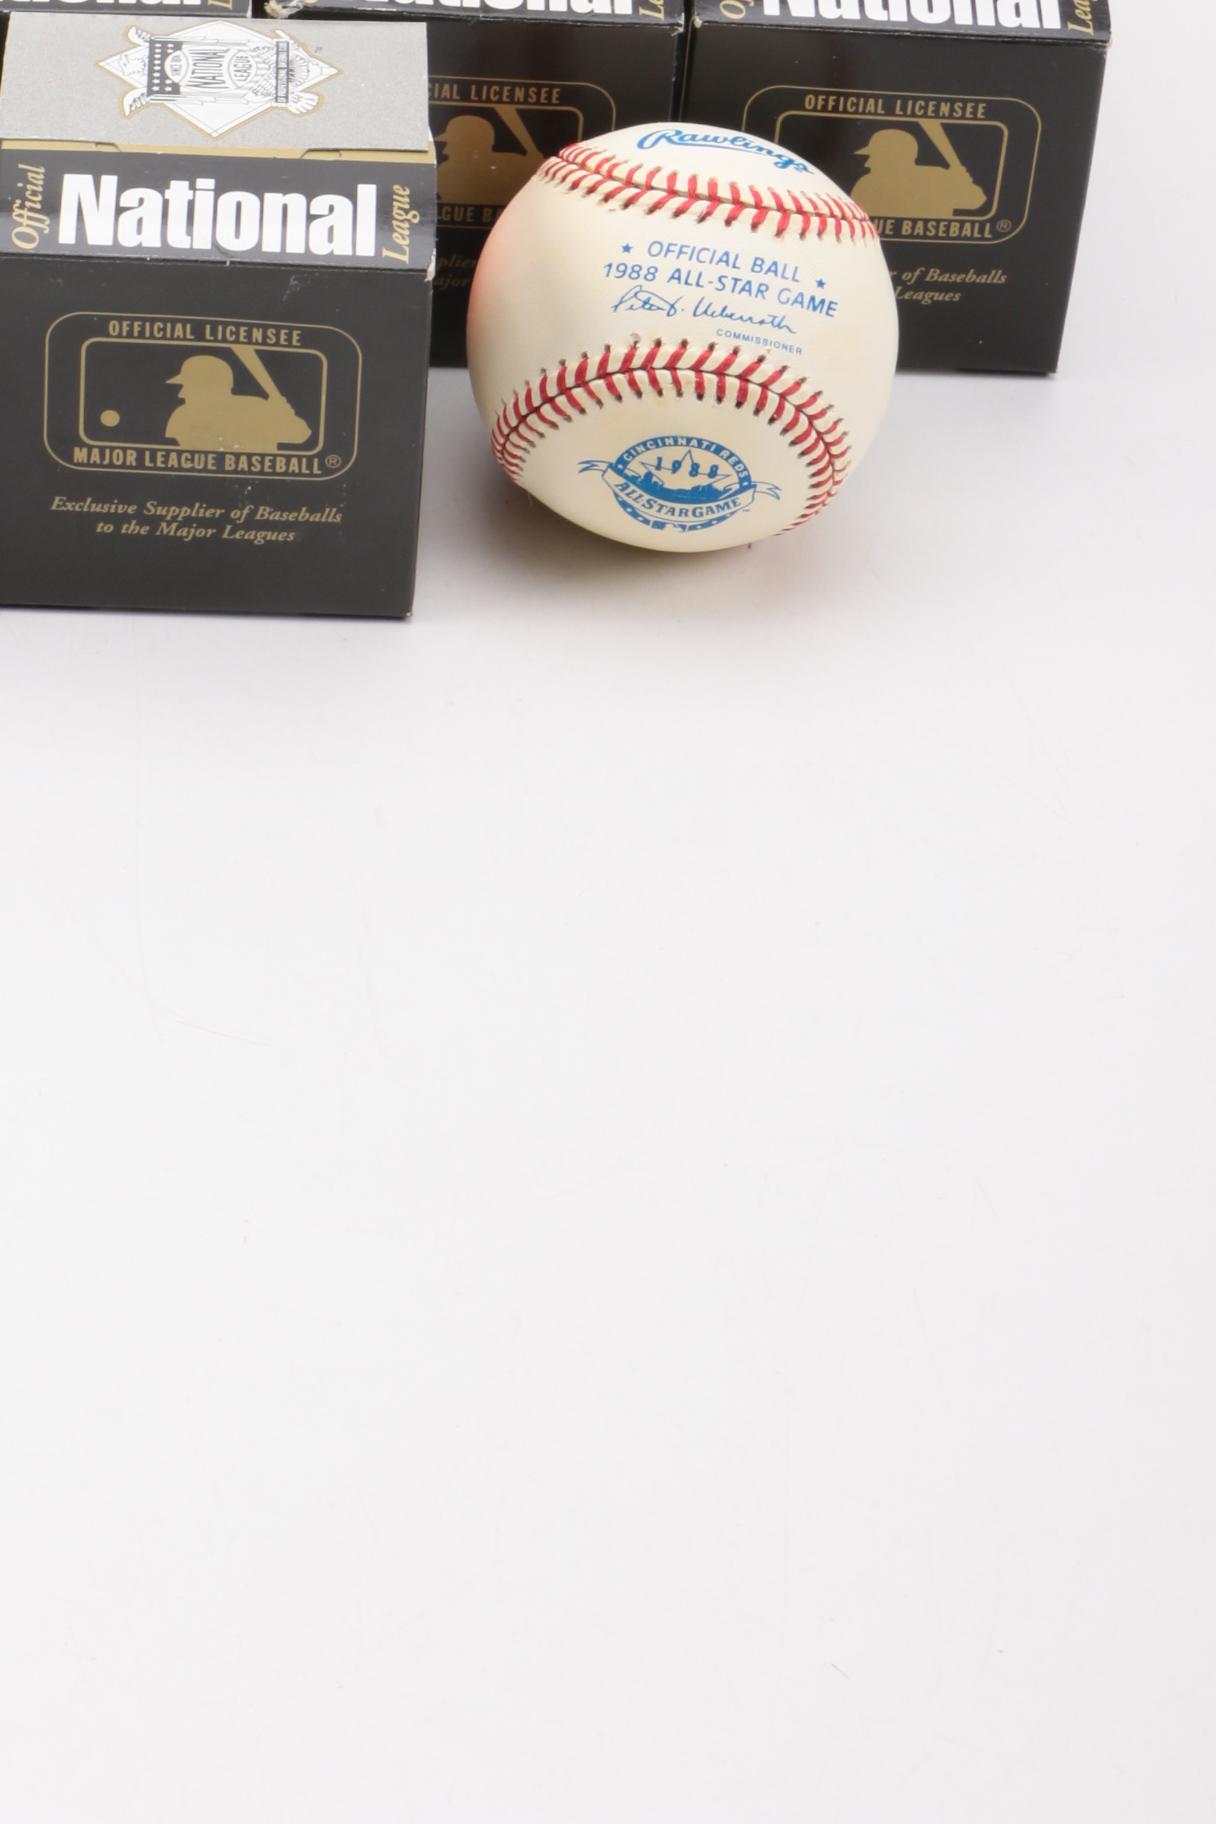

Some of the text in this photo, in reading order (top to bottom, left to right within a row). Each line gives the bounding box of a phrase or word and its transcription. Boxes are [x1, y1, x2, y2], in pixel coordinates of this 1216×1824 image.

[471, 86, 562, 104] LICENSEE
[804, 94, 987, 119] OFFICIAL LICENSEE
[636, 129, 816, 175] Rawlings
[11, 163, 422, 264] Official National League
[647, 240, 802, 283] OFFICIAL BALL
[901, 266, 1008, 285] of Baseballs
[603, 262, 840, 318] 1988 ALL-STAR GAME
[108, 320, 302, 346] OFFICIAL LICENSEE
[716, 328, 803, 356] COMMISSIONER
[73, 446, 137, 467] MAJOR
[144, 450, 217, 471] LEAGUE
[623, 437, 749, 478] CINCINNATI REDS
[50, 496, 343, 525] Exclusive Supplier of Baseballs
[96, 520, 296, 546] to the Major Leagues
